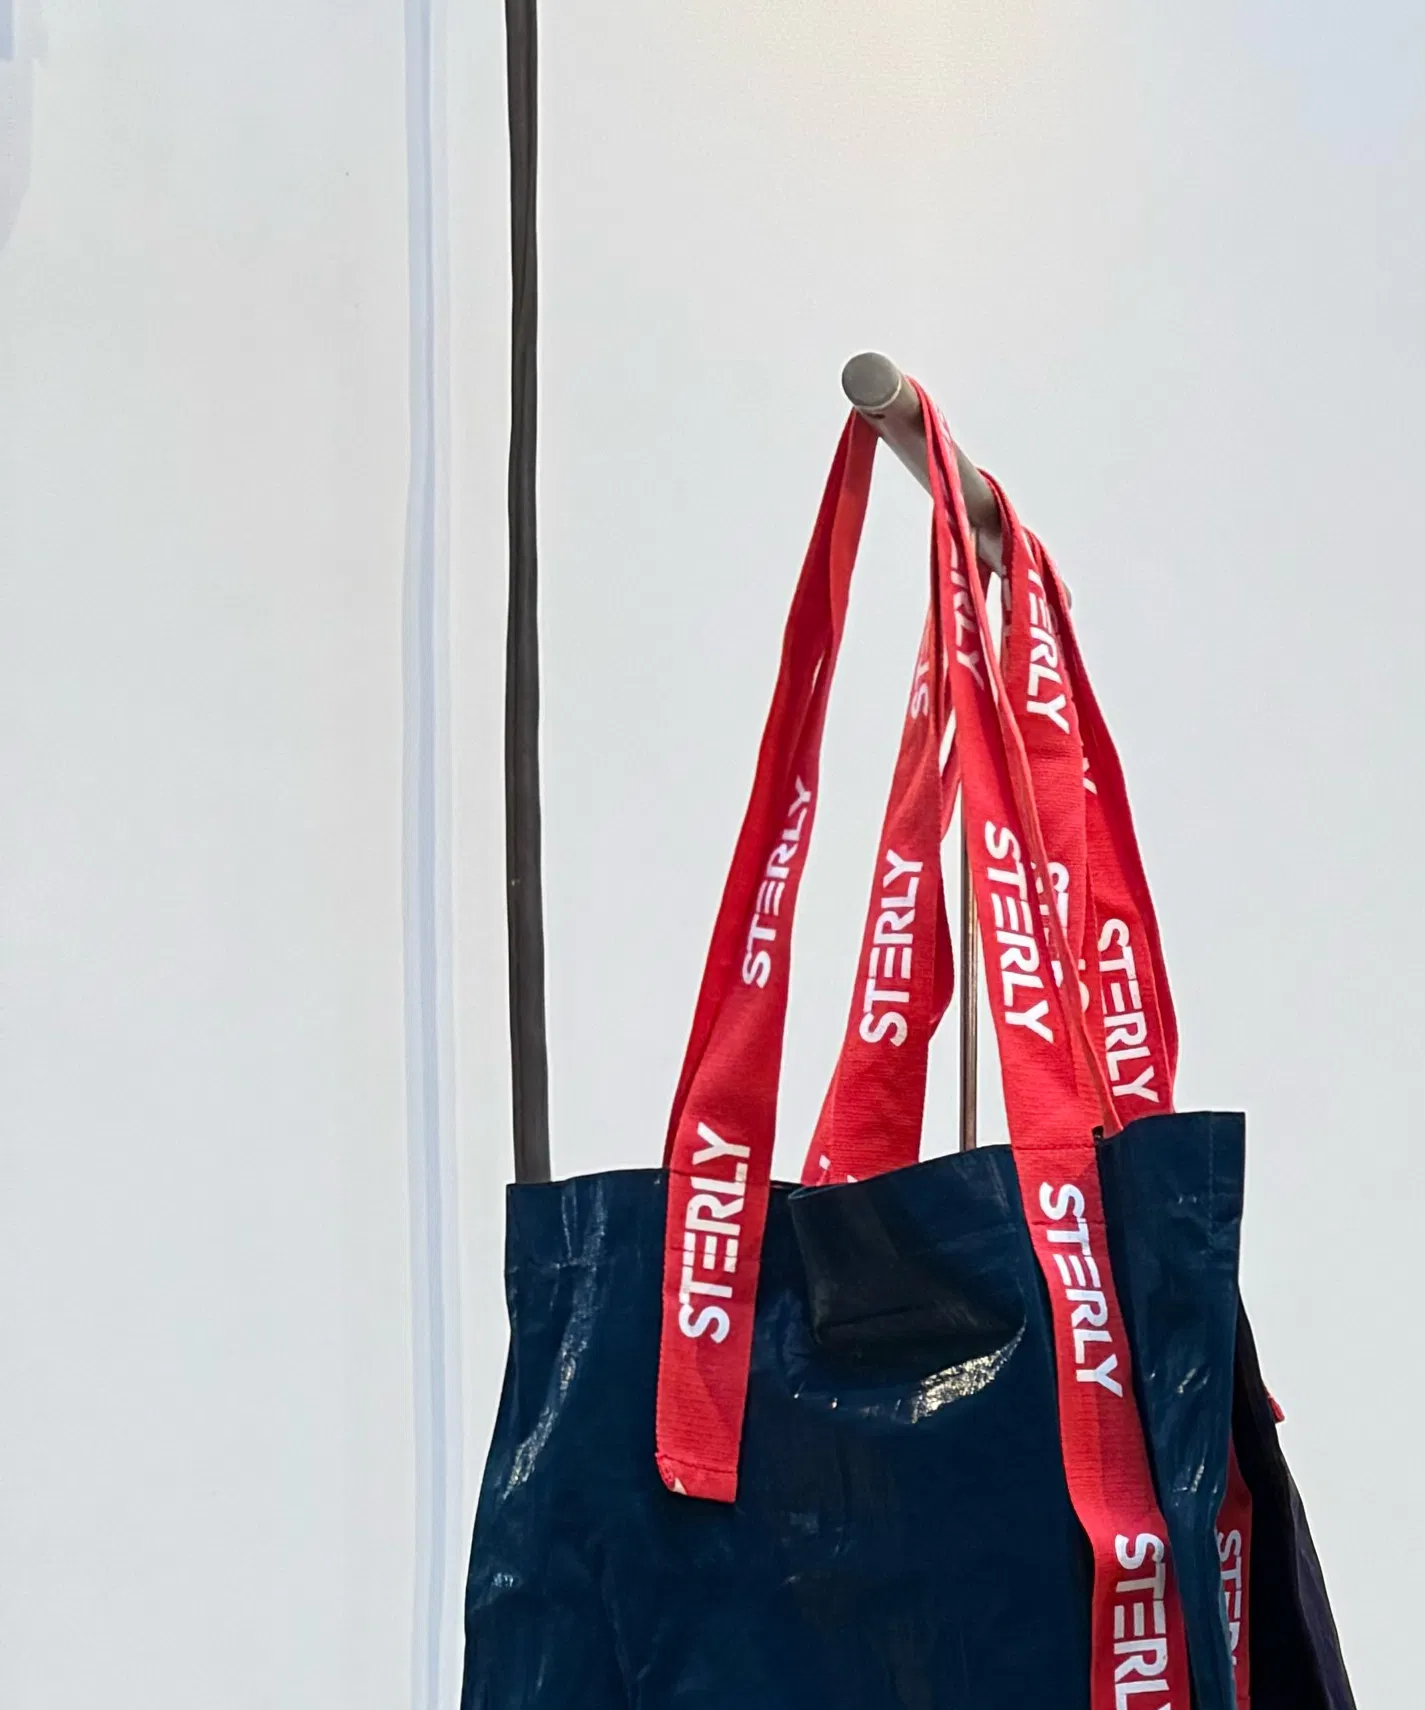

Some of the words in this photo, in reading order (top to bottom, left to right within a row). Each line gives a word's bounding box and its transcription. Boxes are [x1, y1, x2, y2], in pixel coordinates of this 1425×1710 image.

[1026, 568, 1070, 735] TERLY
[741, 776, 812, 989] STERLY
[860, 848, 924, 1047] STERLY
[985, 820, 1055, 1044] STERLY
[1097, 917, 1161, 1104] STERLY
[678, 1121, 751, 1345] STERLY
[1039, 1180, 1124, 1400] STERLY
